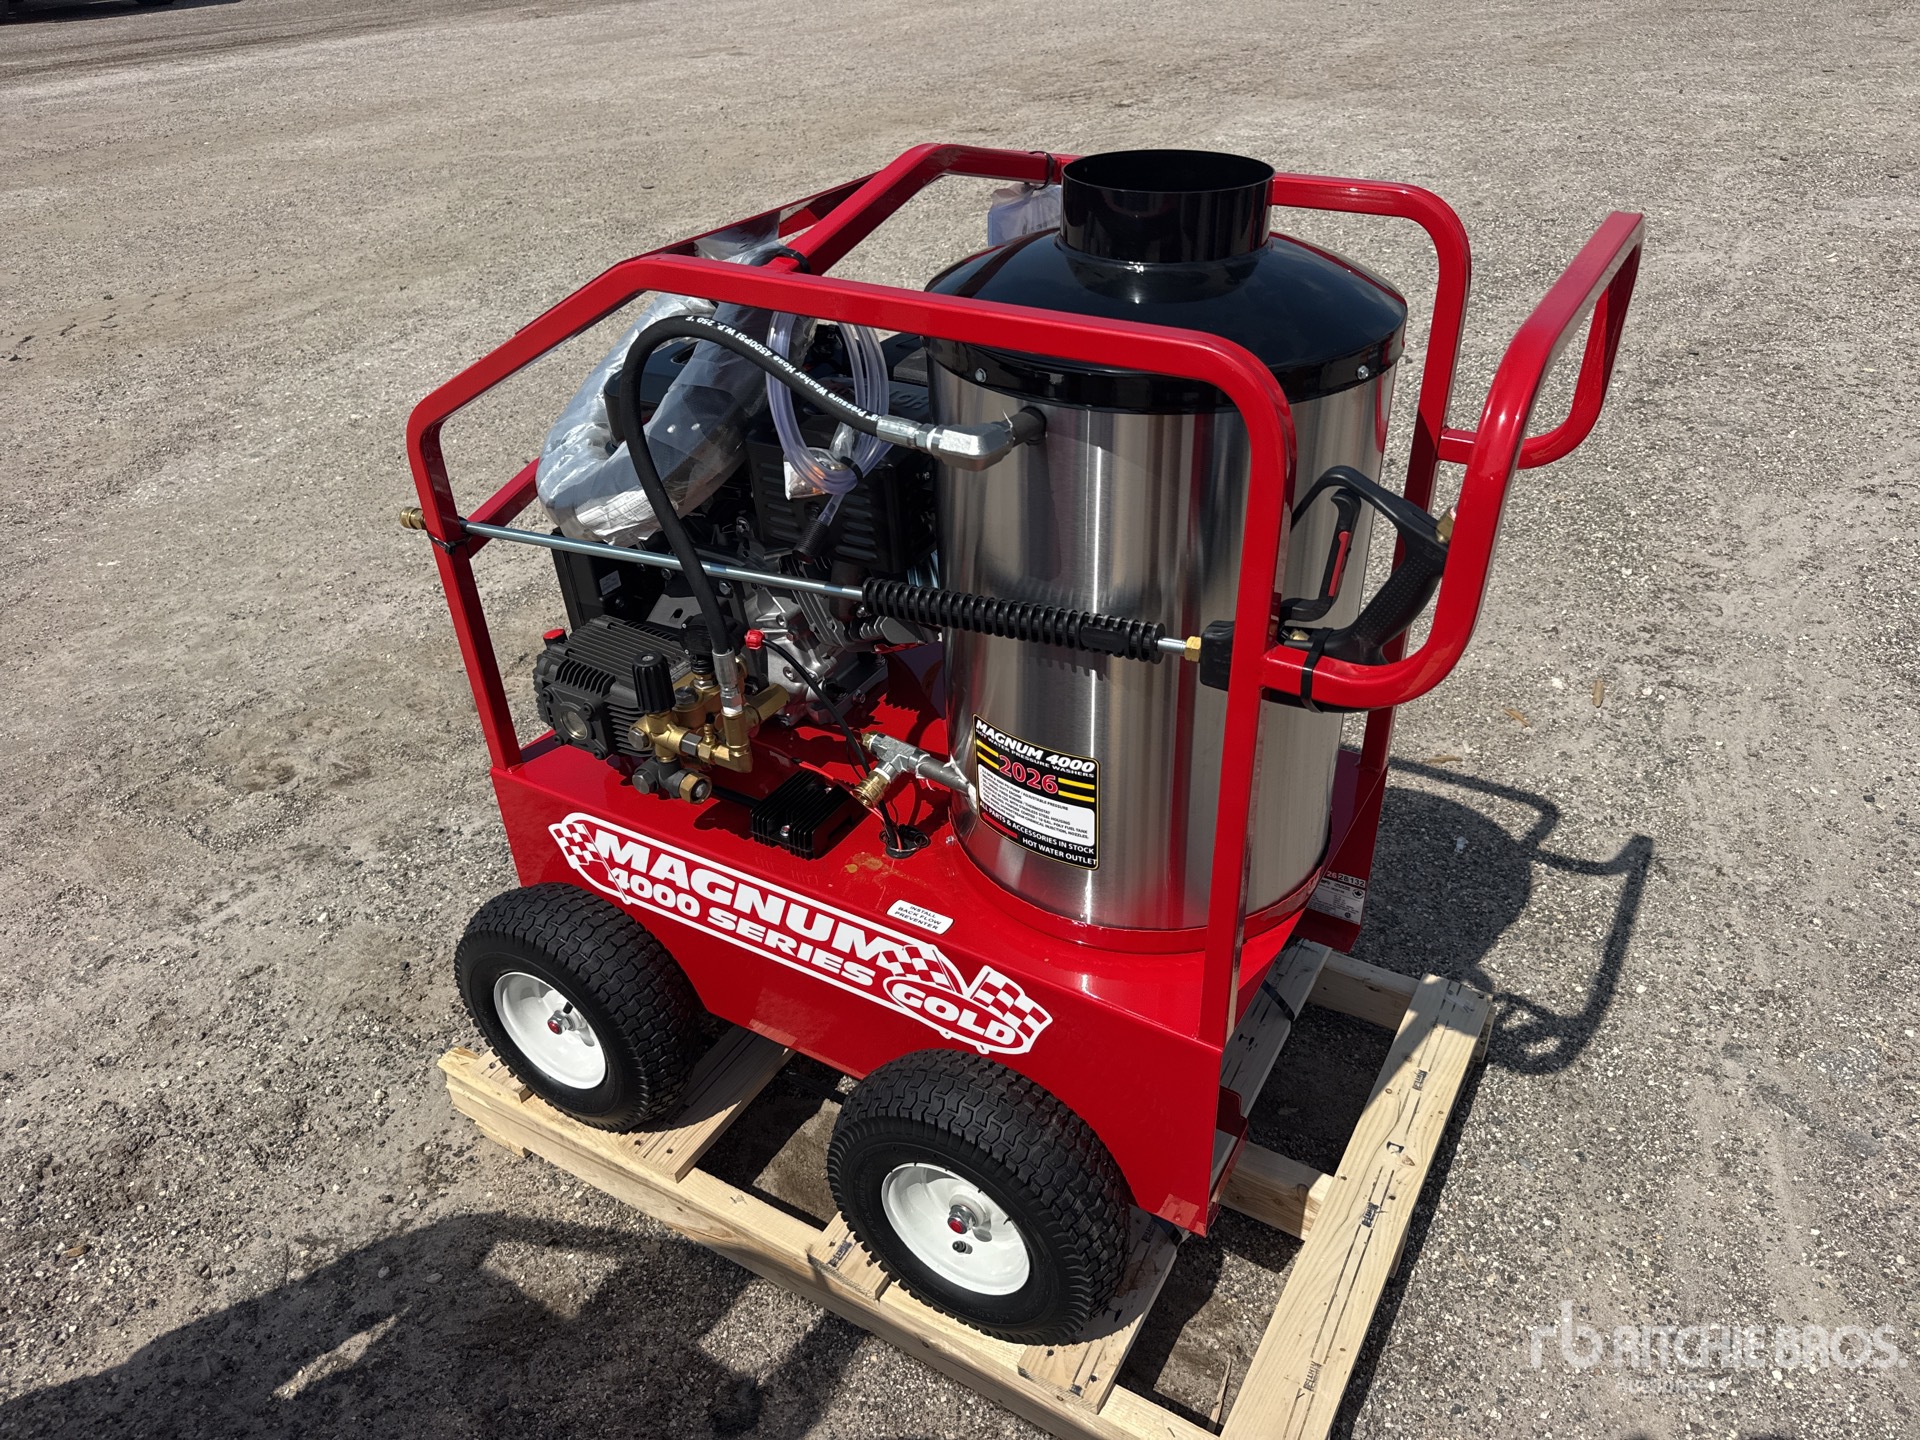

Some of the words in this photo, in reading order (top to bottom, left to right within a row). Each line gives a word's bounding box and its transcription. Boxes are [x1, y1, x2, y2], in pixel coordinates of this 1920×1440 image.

[697, 316, 715, 326] 250
[716, 322, 736, 335] W.P.
[735, 329, 774, 357] 4500PSI
[772, 355, 797, 373] Hose
[794, 371, 829, 397] Washer
[828, 392, 866, 417] Pressure
[976, 719, 1043, 760] MAGNUM
[1046, 754, 1096, 773] 4000
[976, 729, 987, 739] HOT
[988, 739, 1009, 752] WATER
[1011, 751, 1050, 768] PRESSURE
[1052, 765, 1095, 778] WASHERS
[999, 754, 1058, 794] 2026
[1022, 792, 1046, 804] ADJUSTABLE
[1047, 801, 1068, 810] PRESSURE
[1024, 802, 1050, 814] THERMOSTAT
[1018, 804, 1038, 815] STAINLESS
[1050, 816, 1070, 825] HOUSING
[979, 802, 989, 814] ALL
[988, 808, 1006, 823] PARTS
[1006, 818, 1012, 827] &
[1012, 823, 1057, 845] ACCESSORIES
[1058, 840, 1067, 848] IN
[1068, 843, 1094, 855] STOCK
[1022, 837, 1038, 848] HOT
[1038, 843, 1064, 858] WATER
[1065, 852, 1098, 865] OUTLET
[593, 829, 892, 961] MAGNUM
[894, 911, 938, 930] PREVENTER
[898, 907, 918, 917] BACK
[920, 914, 942, 925] FLOW
[910, 906, 936, 918] INSTALL
[607, 866, 701, 920] 4000
[706, 906, 877, 987] SERIES
[890, 982, 1017, 1047] GOLD
